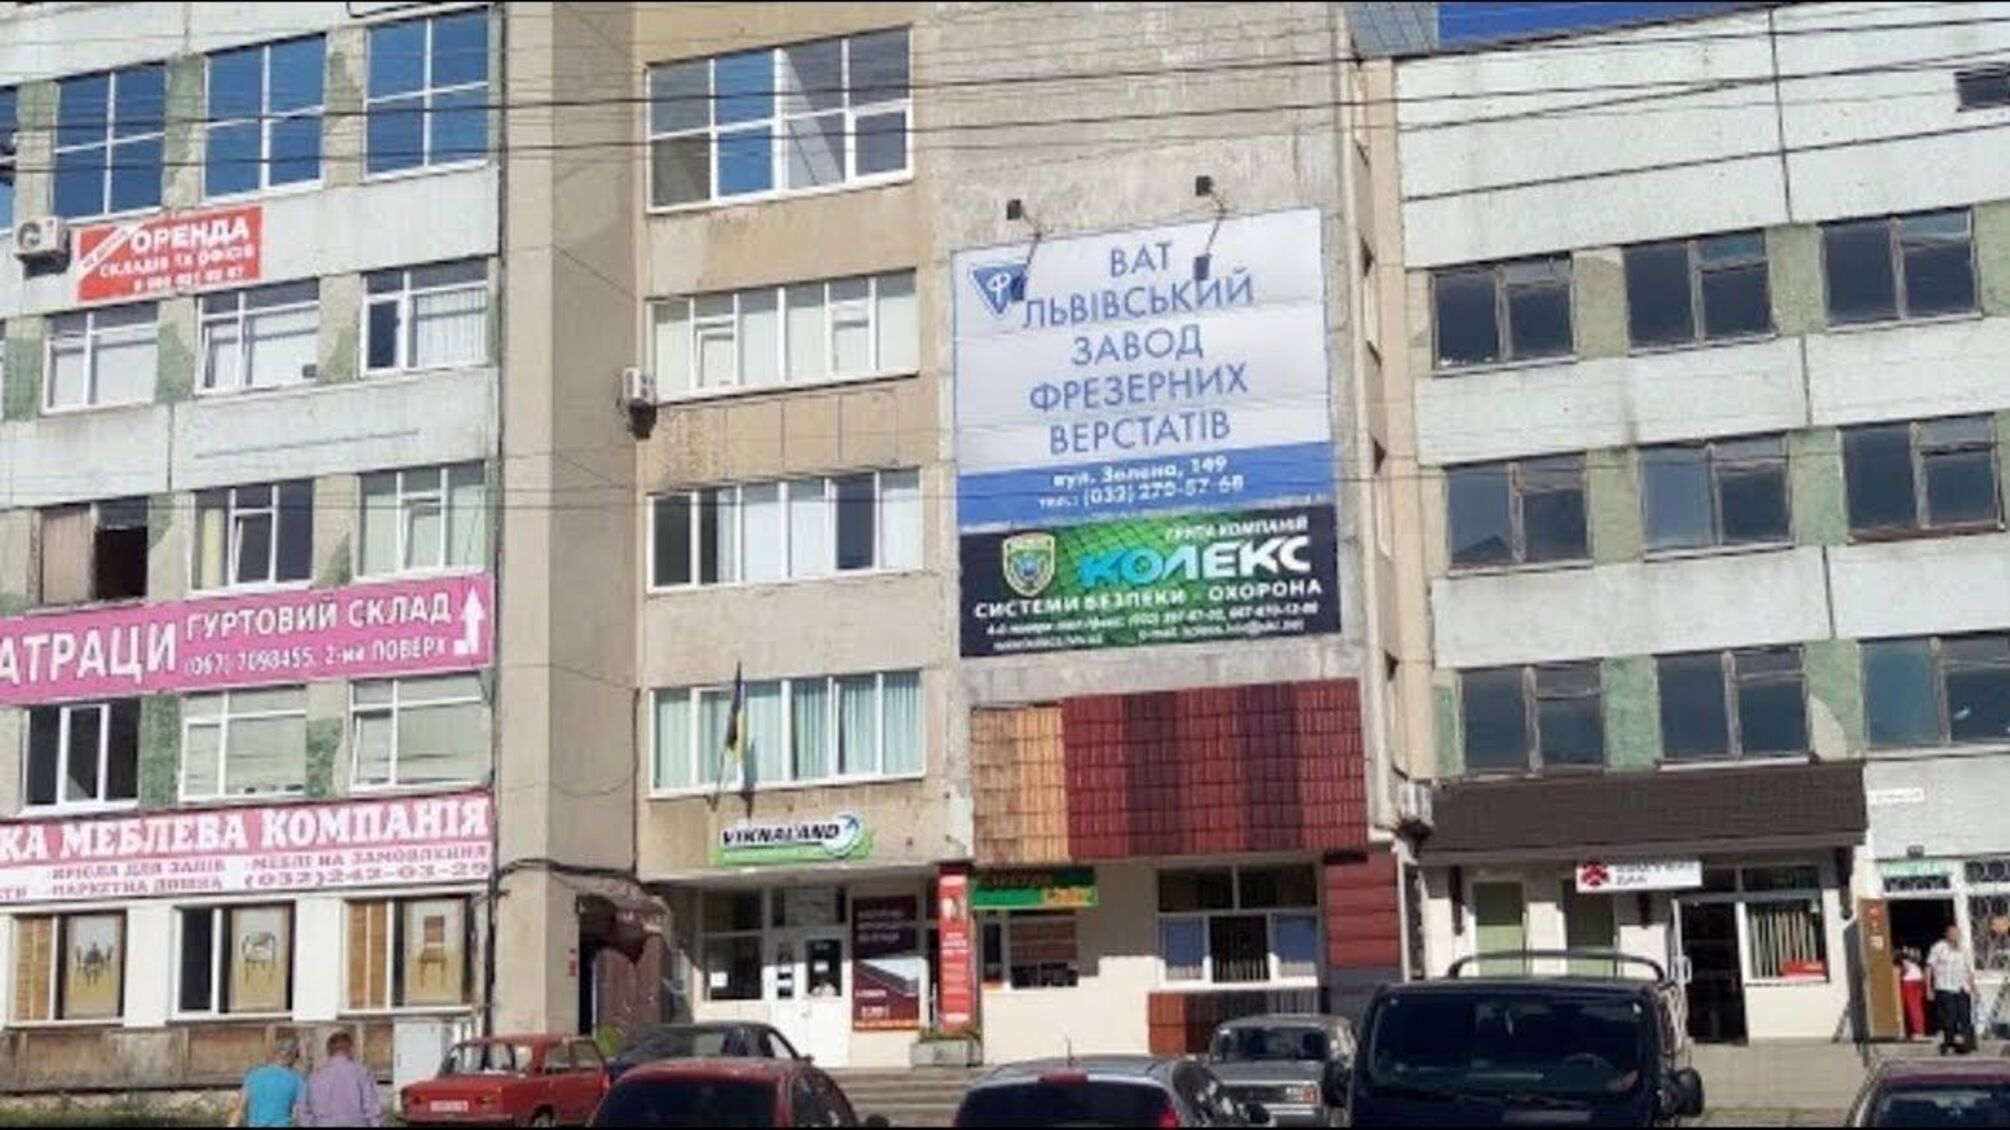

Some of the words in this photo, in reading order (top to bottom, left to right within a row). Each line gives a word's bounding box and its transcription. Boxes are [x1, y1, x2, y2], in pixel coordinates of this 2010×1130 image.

[130, 217, 249, 254] ОРЕНДА
[1110, 241, 1173, 278] ВАТ
[1022, 267, 1254, 329] ЛЬВІВСЬКИЙ
[1071, 324, 1204, 367] ЗАВОД
[1029, 362, 1248, 413] ФРЕЗЕРНИХ
[1049, 410, 1231, 456] ВЕРСТАТІВ
[1053, 472, 1097, 489] вул.
[1190, 455, 1228, 473] 149
[1078, 536, 1313, 589] КОЛЕКС
[187, 593, 338, 642] ГУРТОВИЙ
[349, 591, 452, 629] СКЛАД
[975, 596, 1080, 619] СИСТЕМИ
[1084, 589, 1187, 612] БЕЗПЕКИ
[1208, 578, 1323, 602] ОХОРОНА
[373, 636, 447, 661] ПОВЕРХ
[60, 812, 249, 859] МЕБЛЕВА
[261, 797, 489, 848] КОМПАНІЯ
[723, 823, 840, 844] VIKNALAND
[124, 861, 162, 876] ДЛЯ
[318, 853, 345, 866] НА
